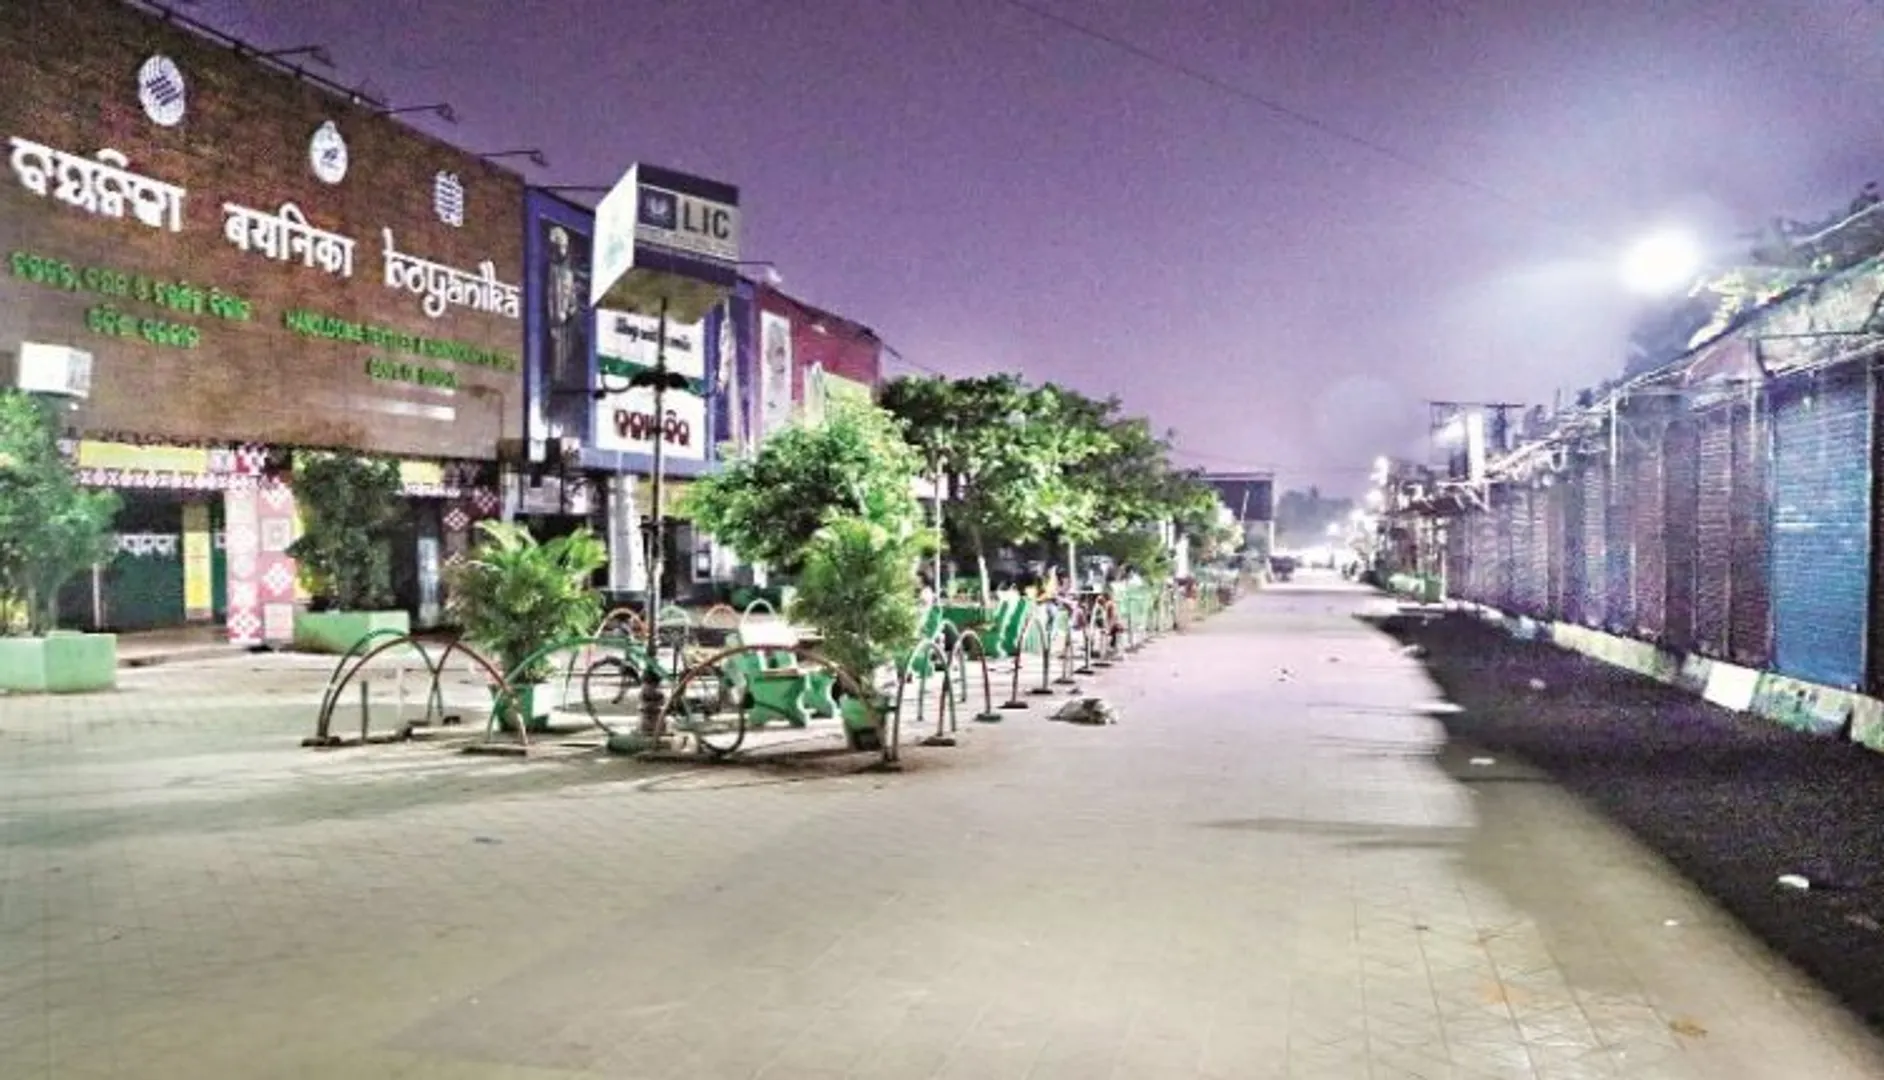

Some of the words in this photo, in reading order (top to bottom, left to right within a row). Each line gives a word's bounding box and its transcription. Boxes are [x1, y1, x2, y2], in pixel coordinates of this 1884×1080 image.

[222, 201, 356, 277] बयनिका
[683, 201, 730, 240] LIC
[381, 226, 521, 318] boyanika
